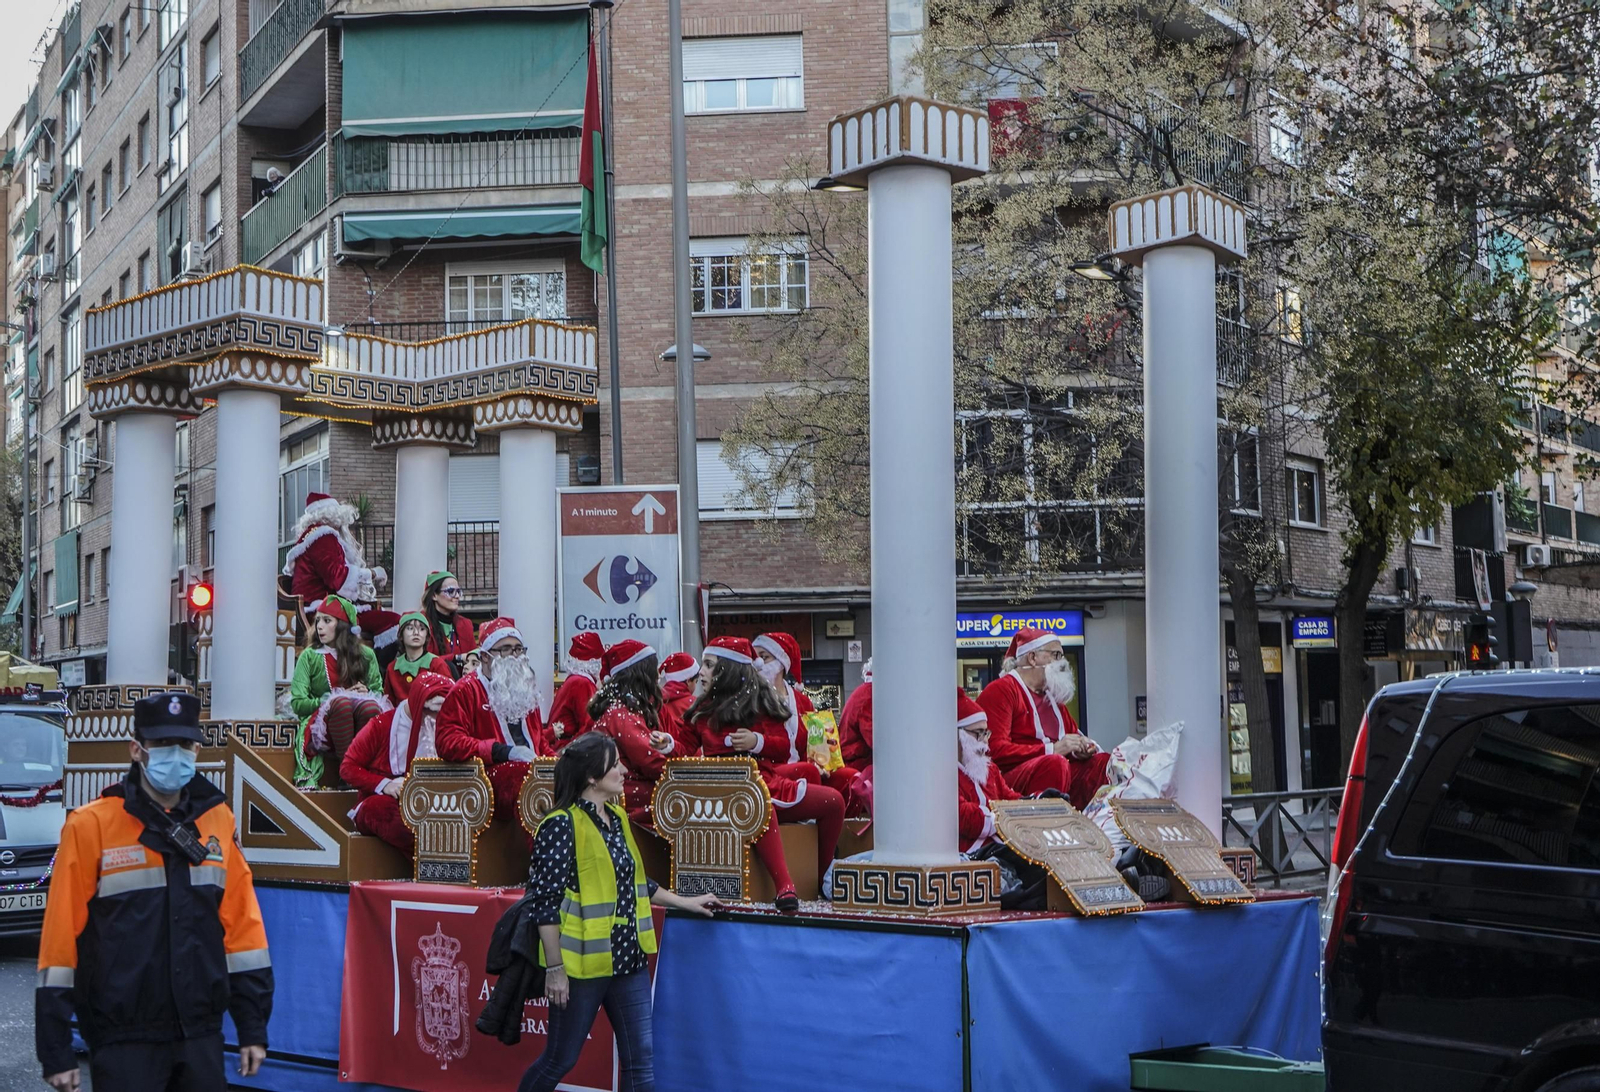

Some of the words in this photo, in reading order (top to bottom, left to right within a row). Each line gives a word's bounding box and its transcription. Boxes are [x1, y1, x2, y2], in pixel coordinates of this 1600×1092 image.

[571, 508, 579, 517] A
[585, 507, 618, 516] minuto
[574, 613, 667, 631] Carrefour
[709, 614, 783, 626] ELOJERIA
[956, 619, 990, 632] UPER
[1003, 618, 1067, 631] EFECTIVO
[1298, 621, 1317, 629] CASA
[1298, 628, 1329, 636] EMPEÑO
[988, 639, 1010, 647] EMPEÑO
[1227, 648, 1239, 659] CAS
[1228, 660, 1240, 672] EMP
[1138, 707, 1147, 718] OR
[104, 857, 139, 868] GRANADA
[20, 894, 43, 908] CTB
